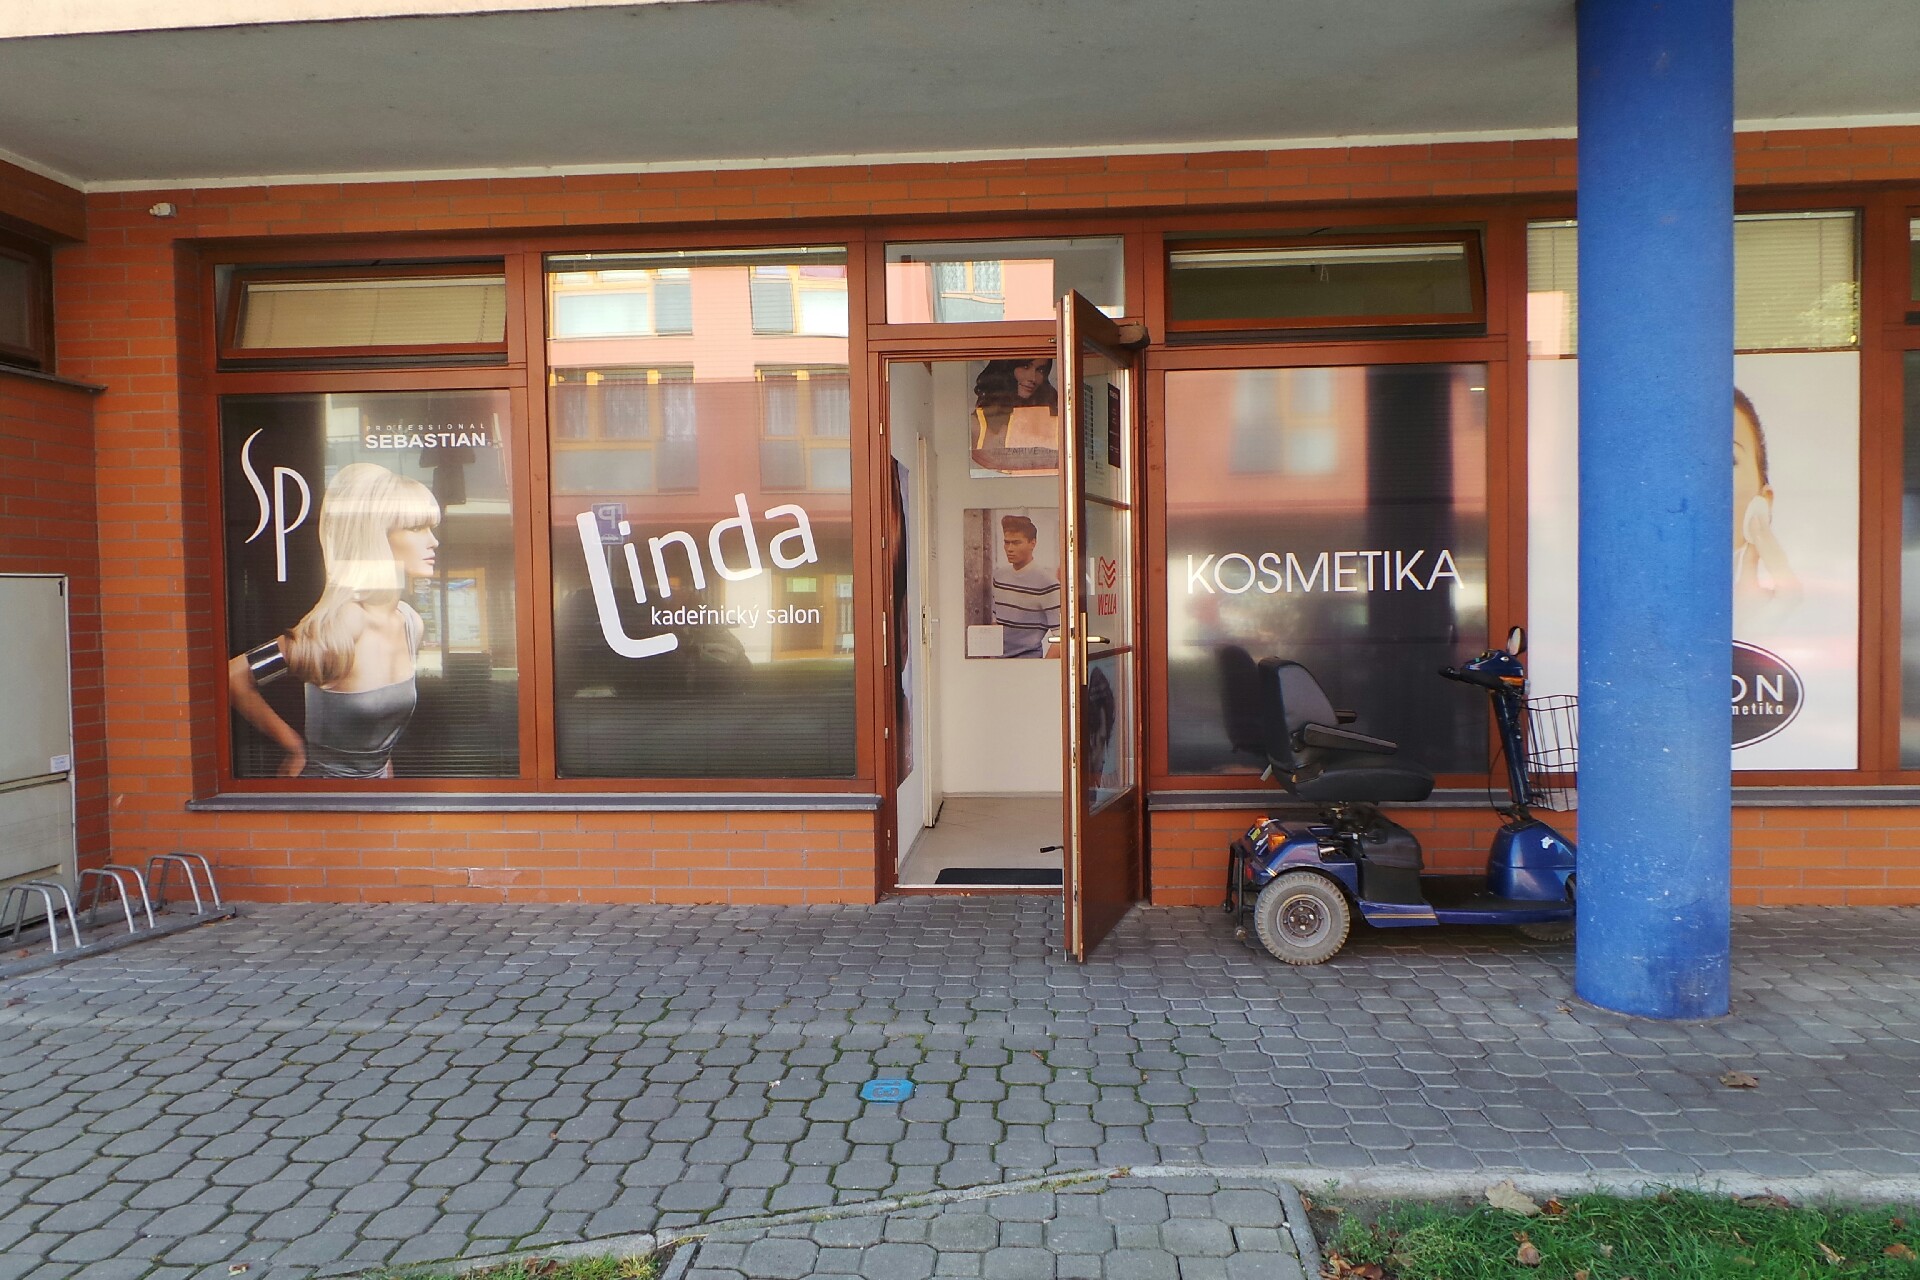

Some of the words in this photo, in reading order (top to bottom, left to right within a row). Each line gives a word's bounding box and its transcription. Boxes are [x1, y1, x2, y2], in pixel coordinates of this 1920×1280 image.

[366, 423, 485, 431] PROFESSIONAL
[365, 432, 486, 449] SEBASTIAN
[576, 493, 818, 659] Linda
[1187, 549, 1464, 595] KOSMETIKA
[651, 604, 760, 628] kadeřnický
[766, 604, 820, 625] salon
[1097, 593, 1117, 616] WELLA
